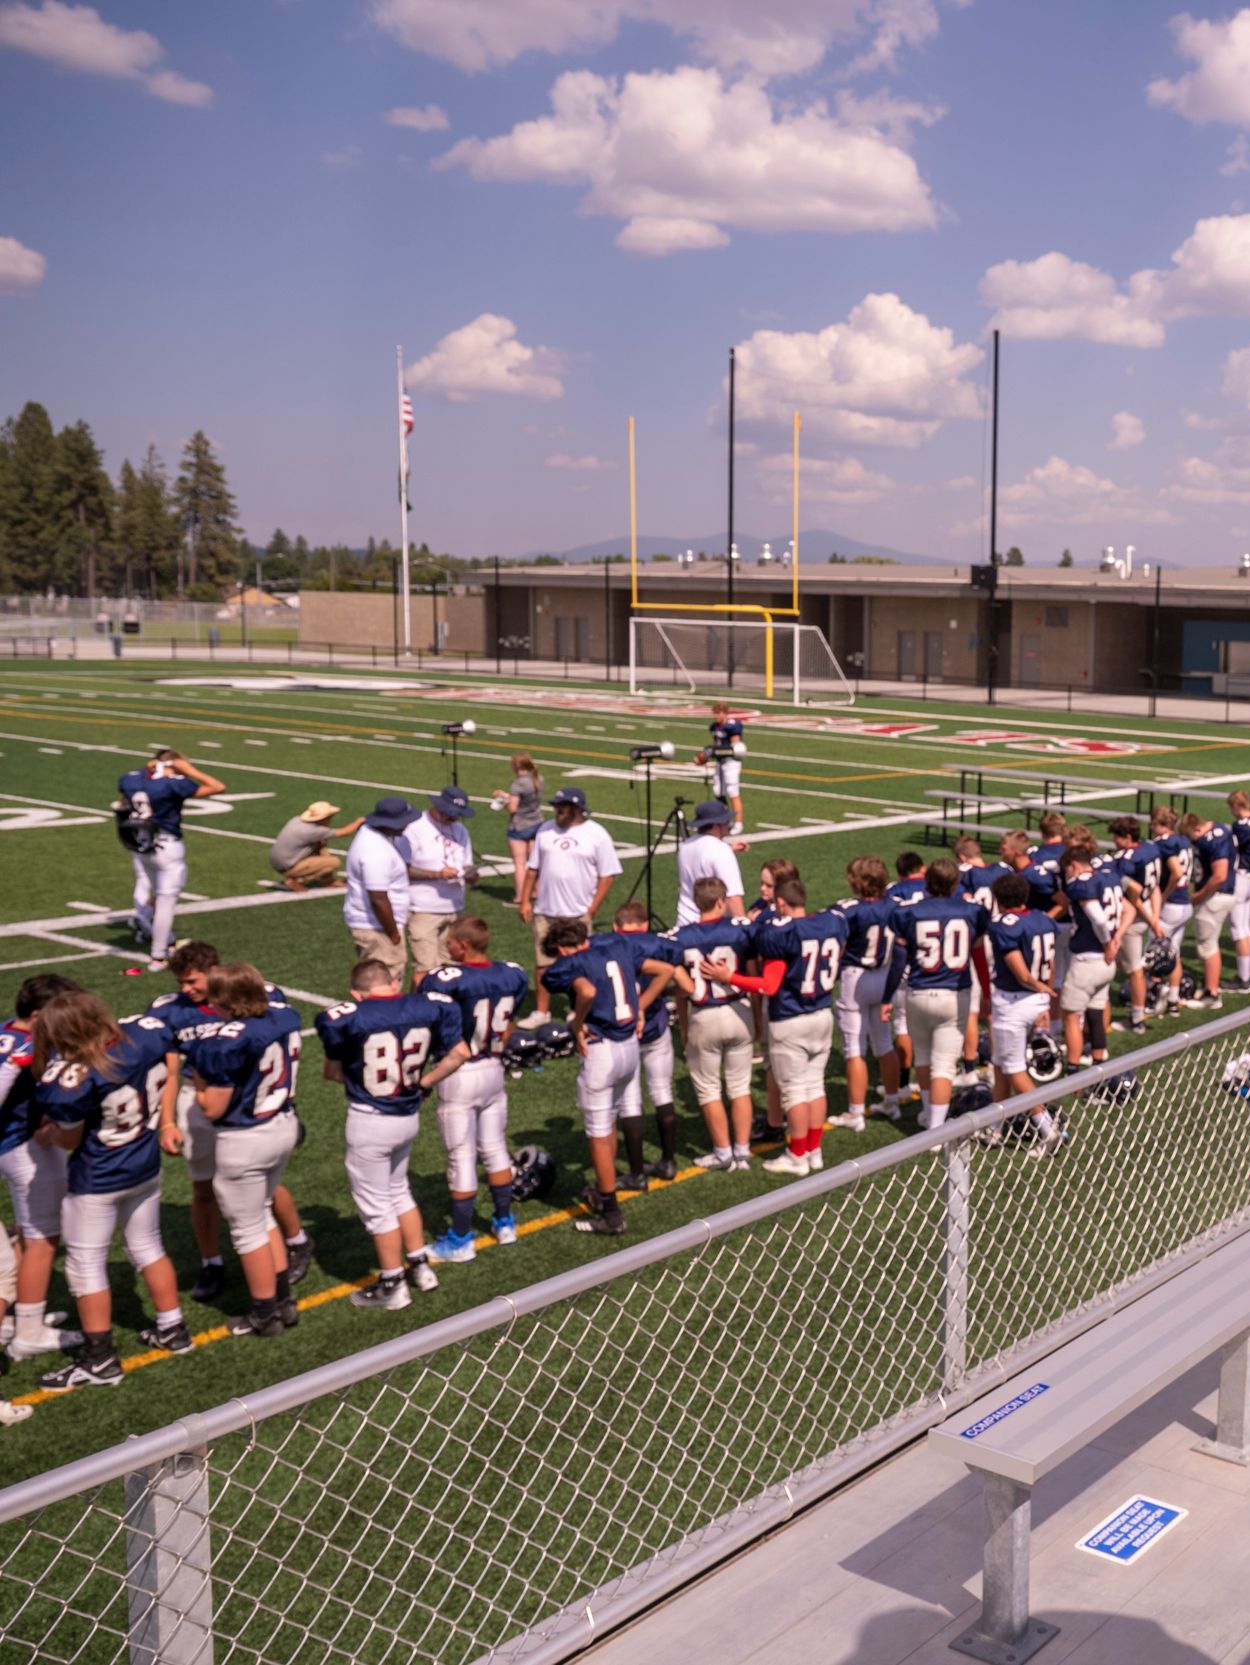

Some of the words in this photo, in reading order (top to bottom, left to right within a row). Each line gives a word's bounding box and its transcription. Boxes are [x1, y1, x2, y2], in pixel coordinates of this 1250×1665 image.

[801, 937, 841, 996] 73
[916, 918, 970, 970] 50
[606, 960, 634, 1024] 1
[363, 1027, 432, 1097] 82
[966, 1398, 1024, 1437] COMPANION
[1020, 1385, 1046, 1401] SEAT
